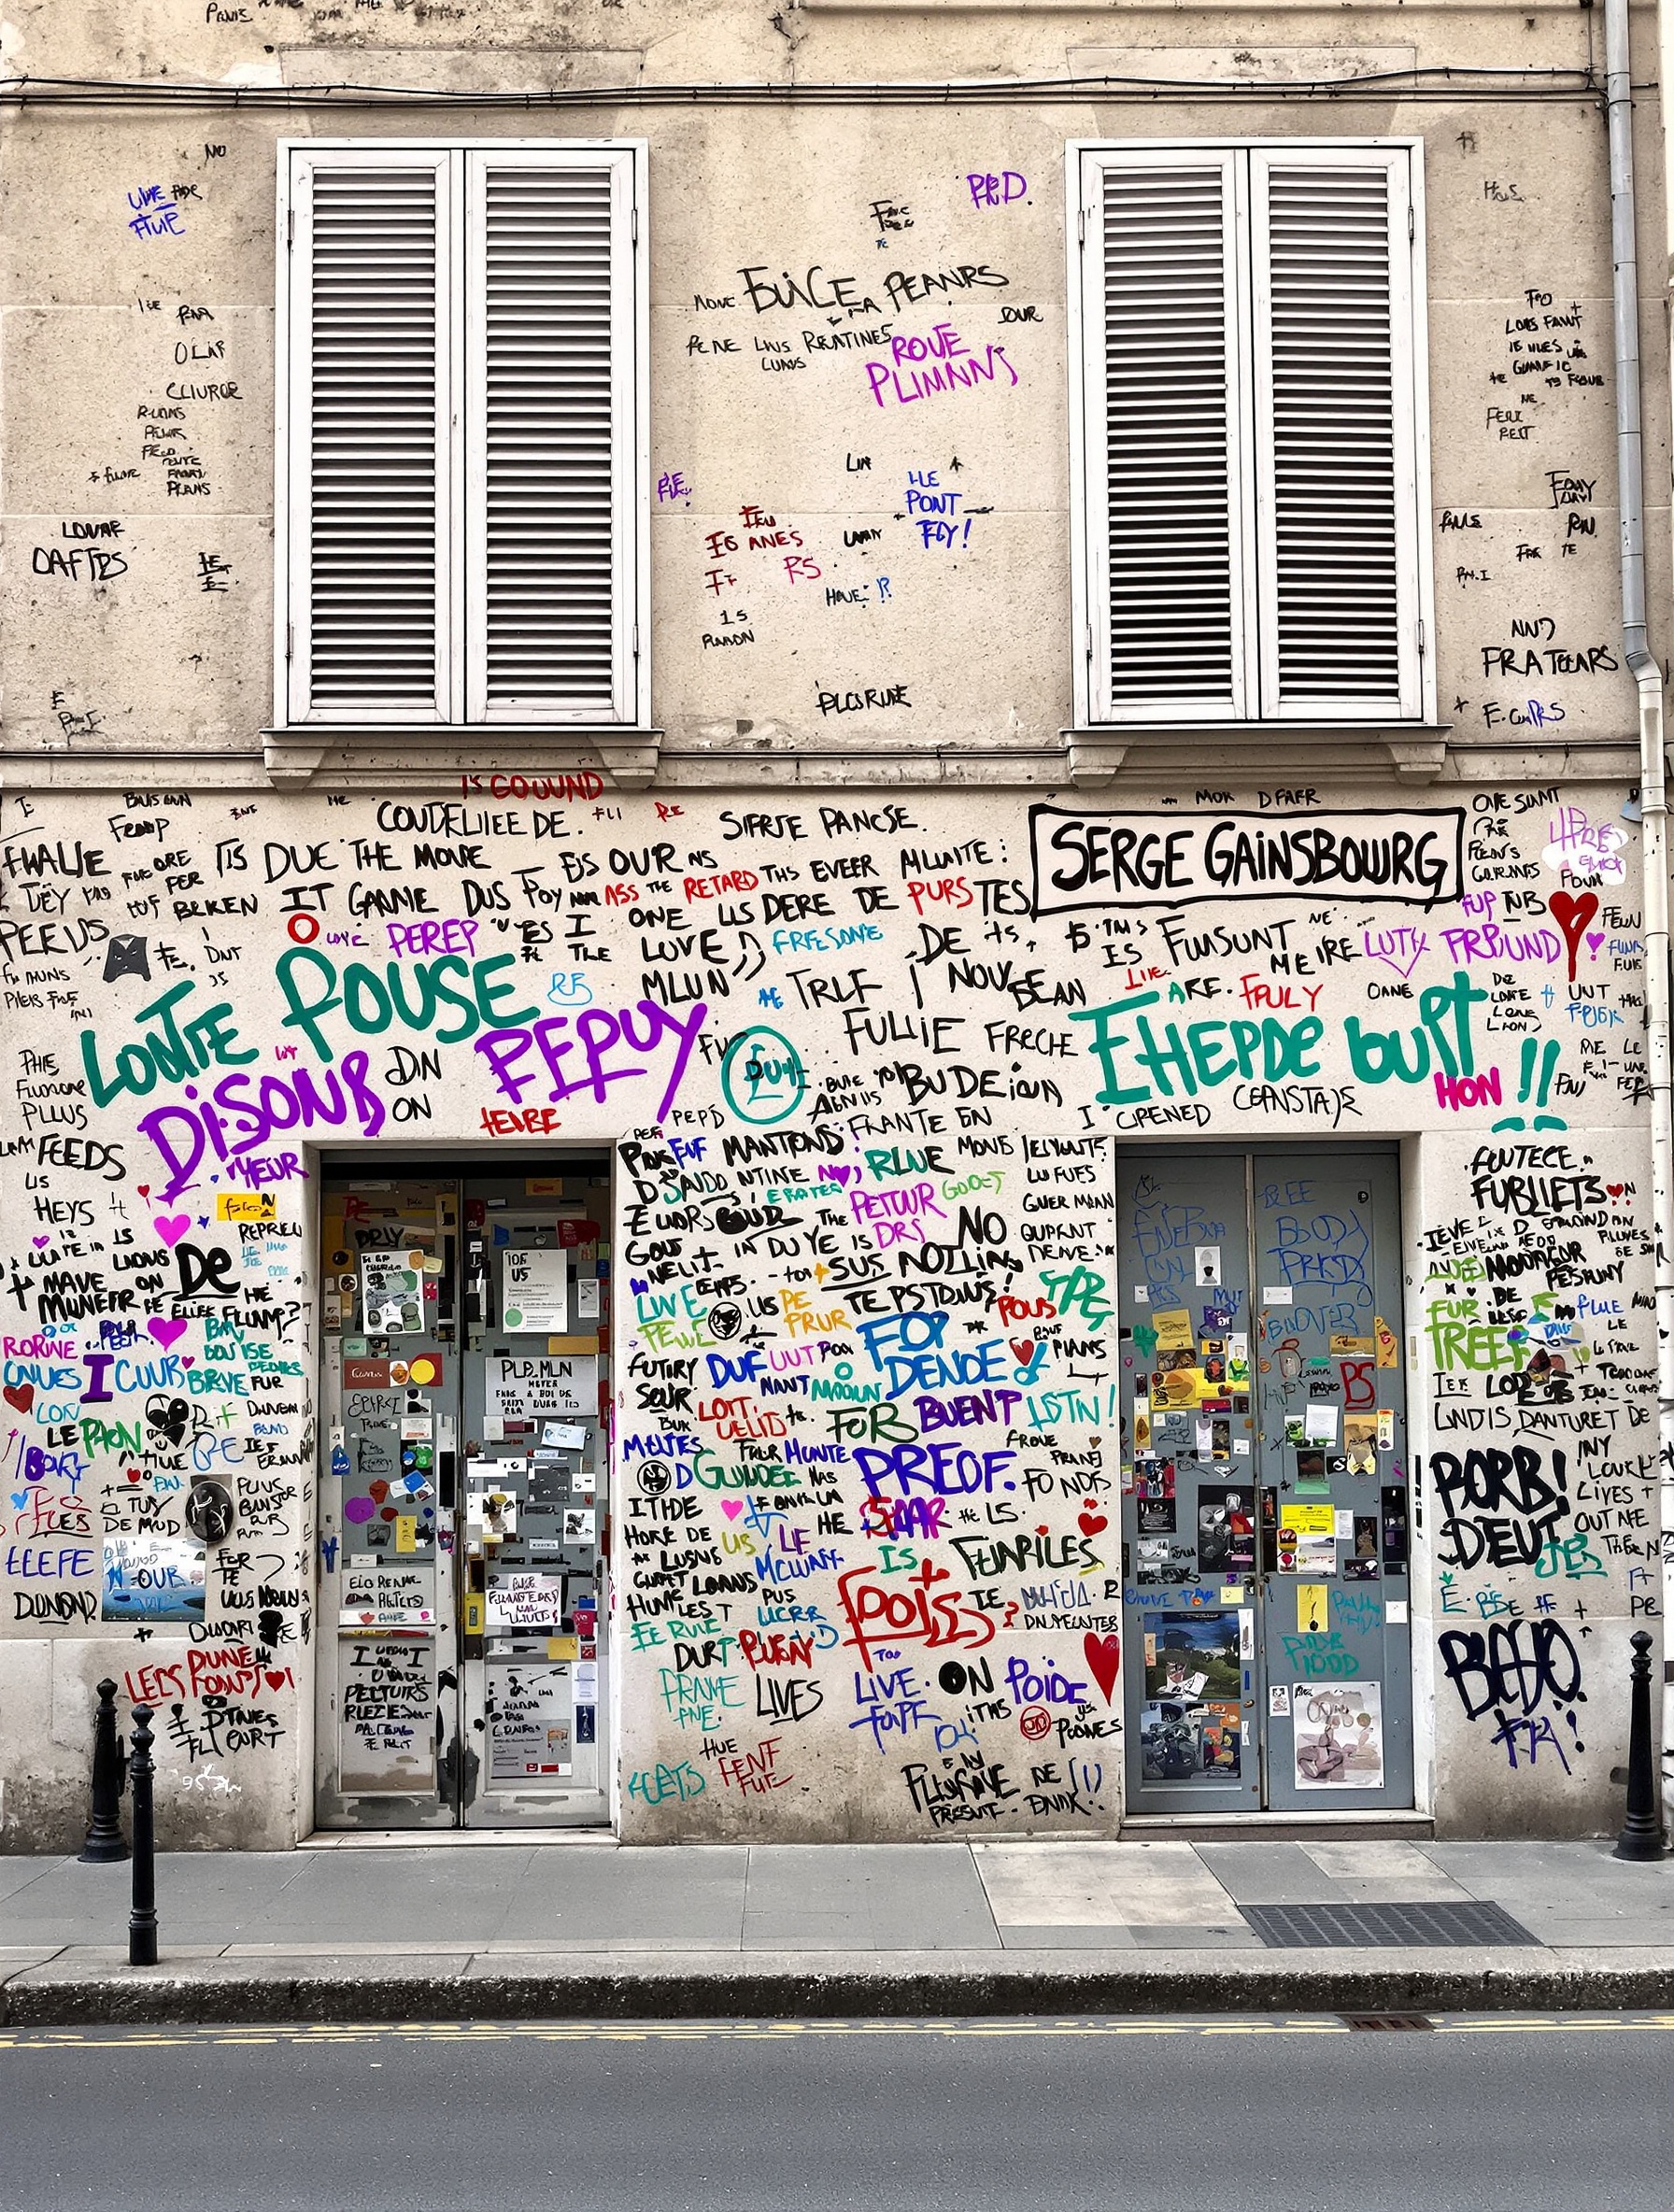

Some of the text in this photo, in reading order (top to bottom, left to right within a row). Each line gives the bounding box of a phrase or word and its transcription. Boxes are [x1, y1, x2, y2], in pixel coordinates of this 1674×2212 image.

[609, 844, 684, 875] OUR
[1051, 821, 1194, 892] SERGE
[683, 871, 759, 902] RETARD
[958, 1206, 1007, 1248] NO
[938, 1655, 995, 1696] ON
